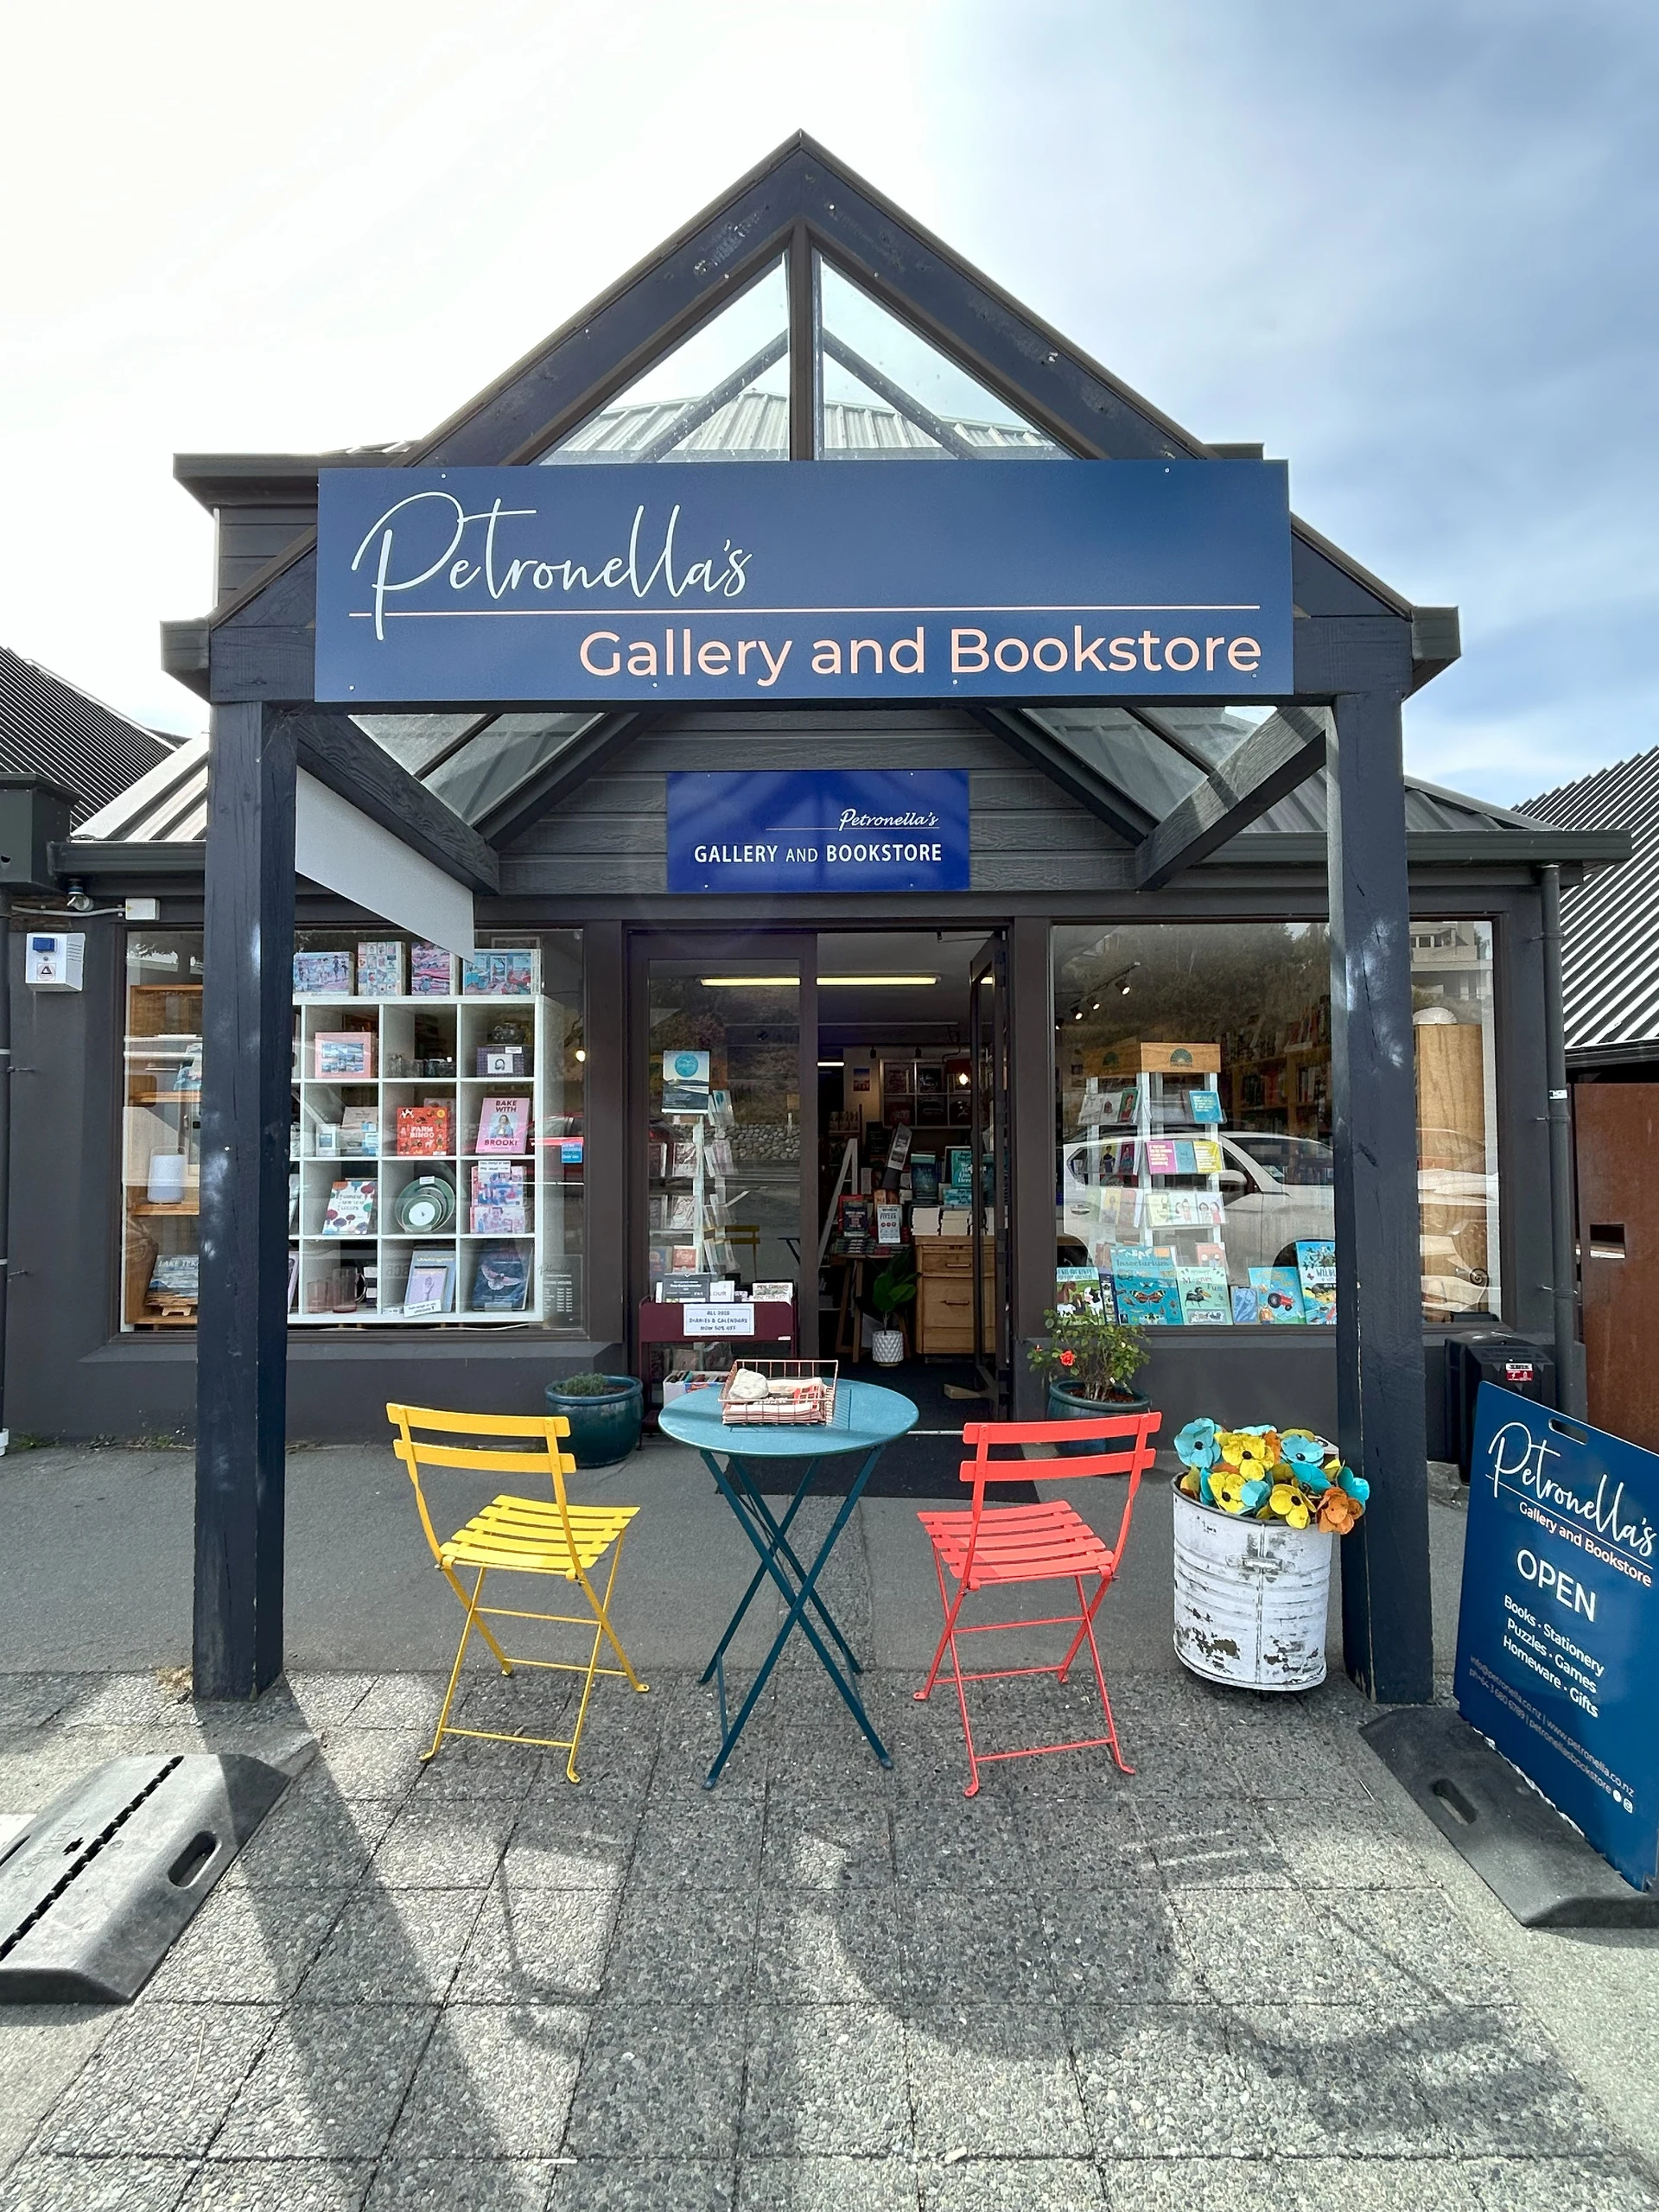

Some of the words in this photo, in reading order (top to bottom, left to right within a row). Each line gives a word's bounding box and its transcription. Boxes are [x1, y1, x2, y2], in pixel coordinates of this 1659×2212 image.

[351, 491, 753, 641] Petronella's
[579, 628, 792, 688] Gallery
[810, 626, 925, 675] and
[950, 625, 1262, 674] Bookstore
[694, 845, 778, 863] GALLERY
[785, 847, 818, 863] AND
[826, 843, 942, 862] BOOKSTORE
[838, 808, 939, 831] Petronella's
[1116, 1258, 1169, 1267] Insectarium
[1315, 1268, 1337, 1277] WILDL
[1488, 1422, 1656, 1556] Petronella's
[1519, 1502, 1557, 1534] Gallery
[1559, 1526, 1582, 1547] and
[1585, 1538, 1652, 1587] Bookstore
[1517, 1549, 1597, 1622] OPEN
[1504, 1594, 1536, 1627] Books
[1543, 1623, 1605, 1677] Stationery
[1507, 1618, 1547, 1656] Puzzles
[1554, 1654, 1597, 1694] Games
[1503, 1635, 1561, 1688] Homeware
[1570, 1687, 1599, 1718] Gifts
